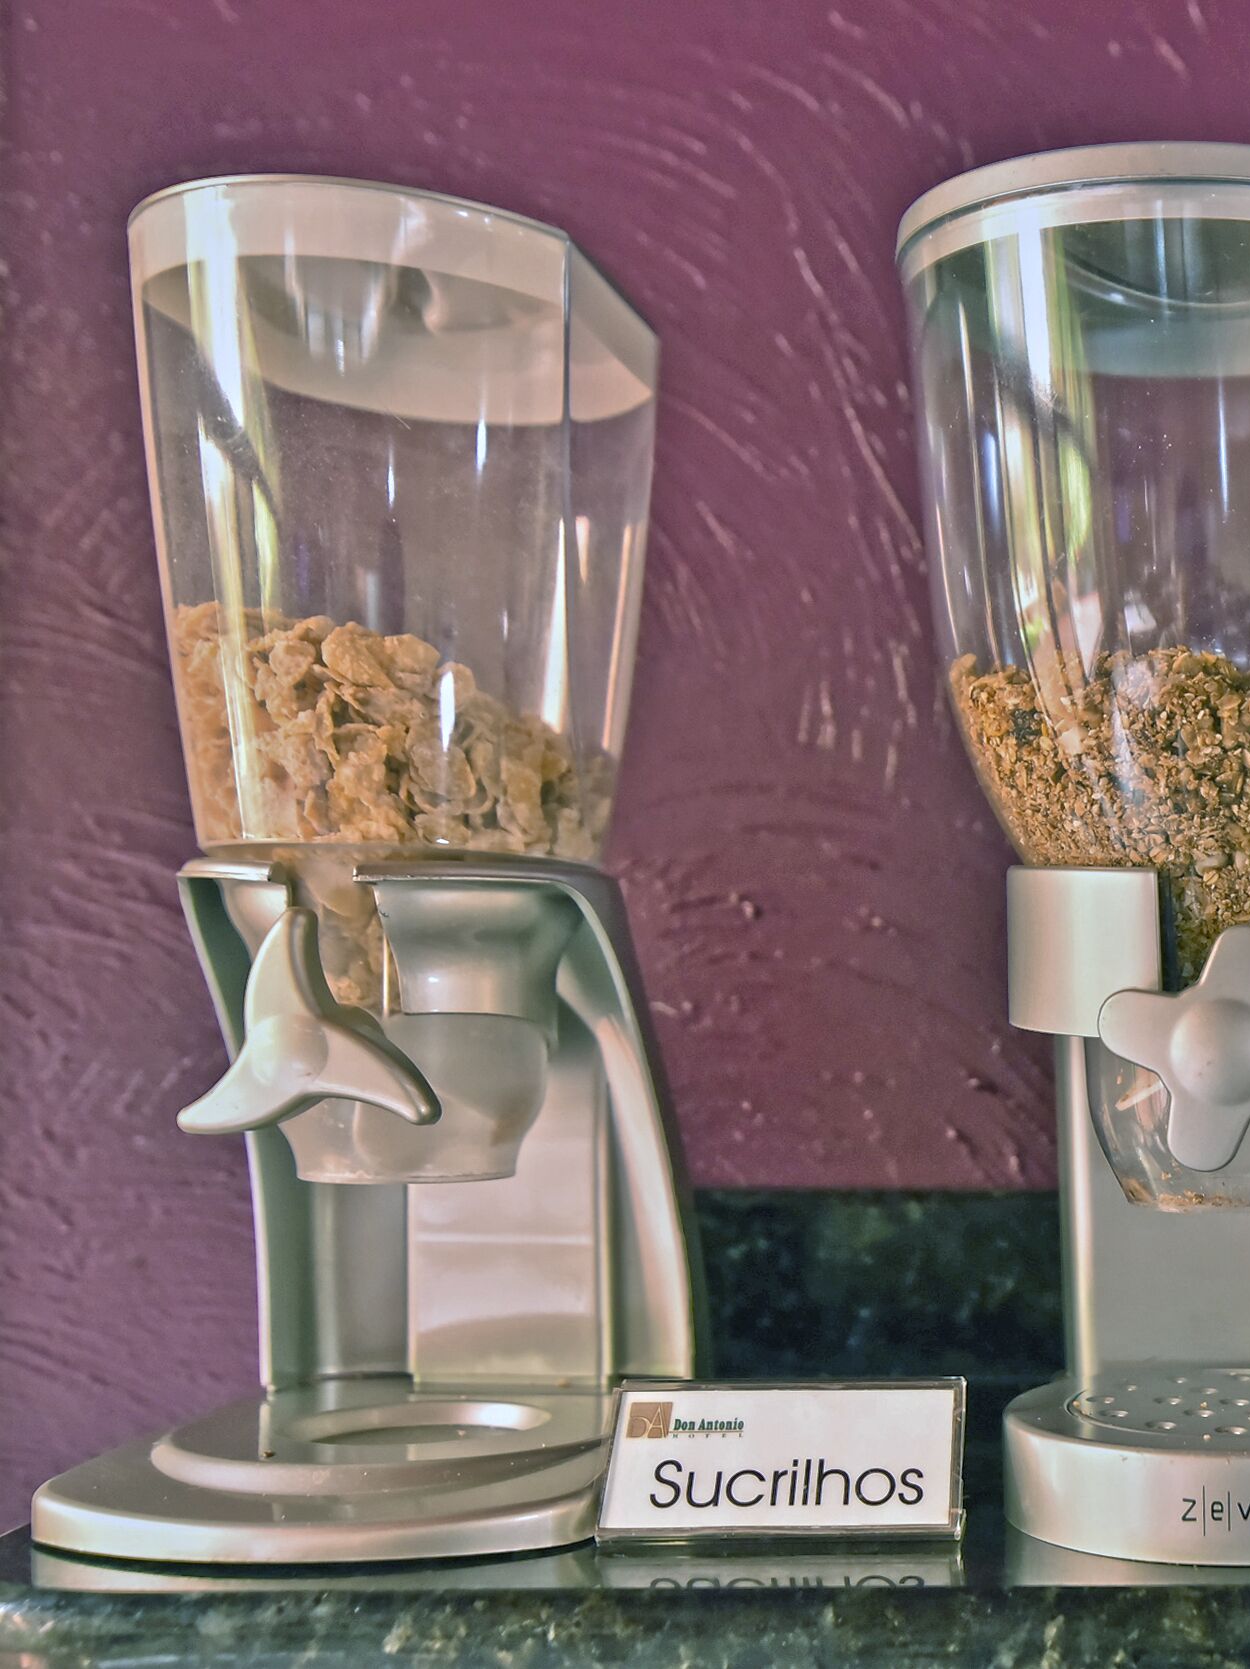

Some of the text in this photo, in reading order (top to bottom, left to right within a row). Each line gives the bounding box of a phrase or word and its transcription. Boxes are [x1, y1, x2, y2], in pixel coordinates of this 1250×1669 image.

[674, 1418, 744, 1430] Don Antonio
[649, 1458, 925, 1508] Sucrilhos
